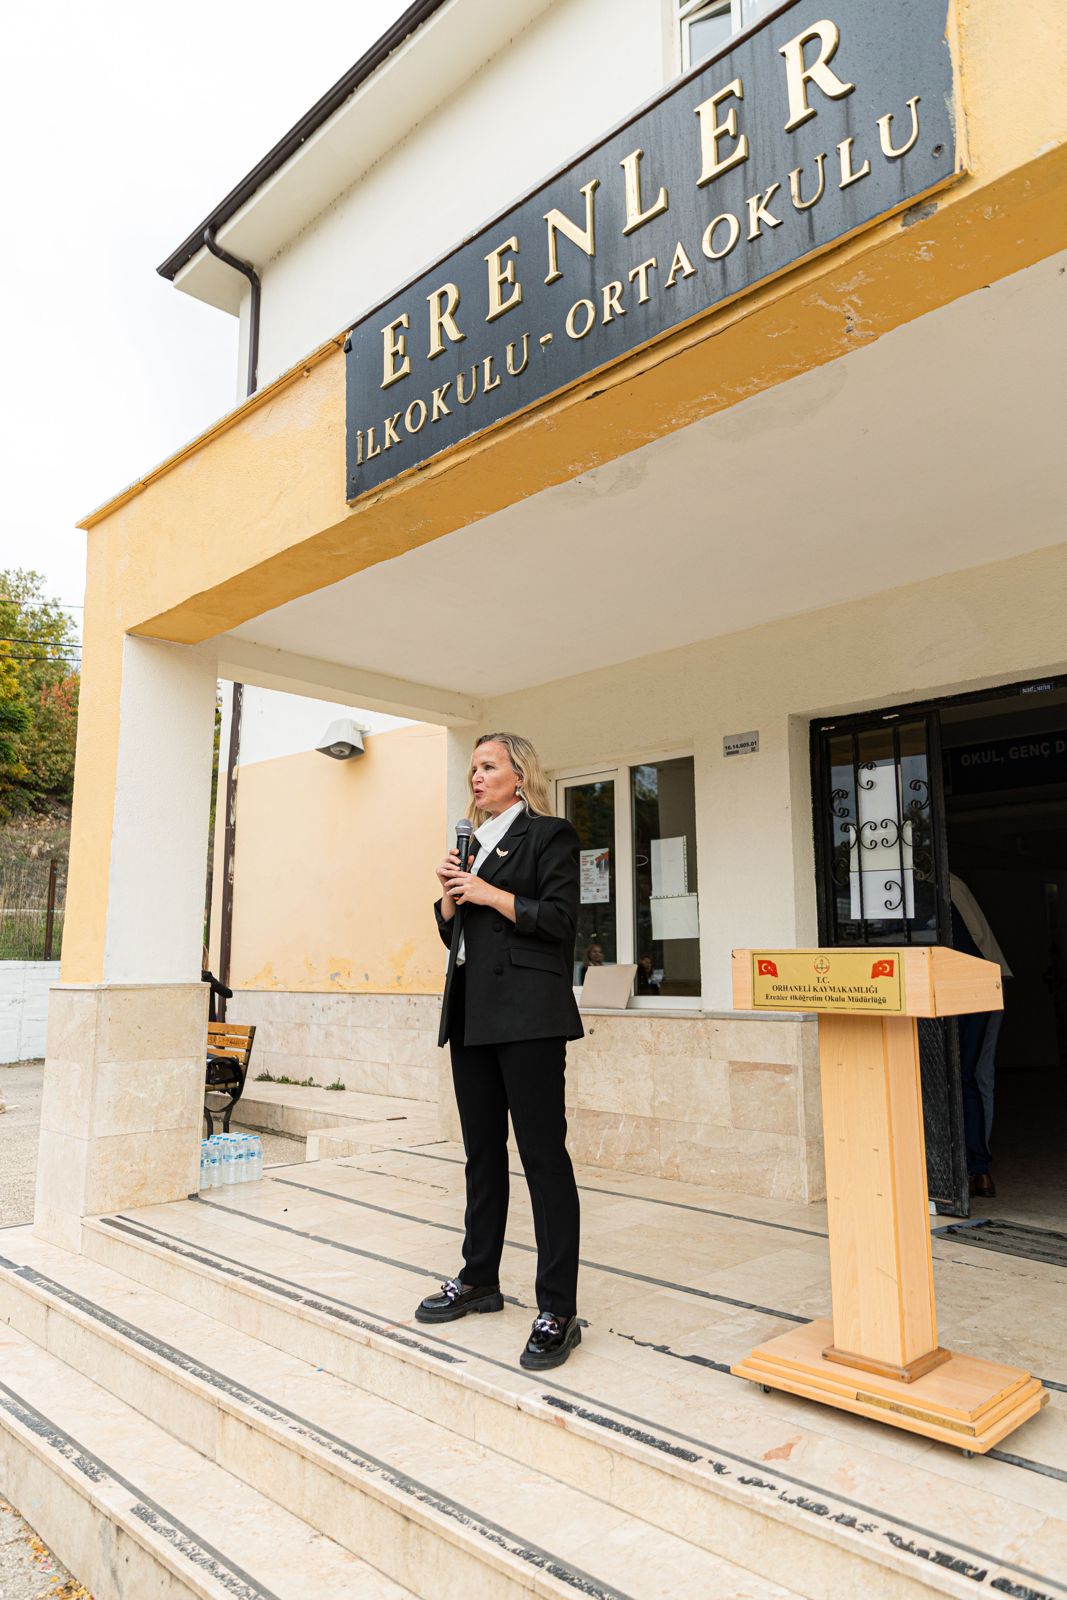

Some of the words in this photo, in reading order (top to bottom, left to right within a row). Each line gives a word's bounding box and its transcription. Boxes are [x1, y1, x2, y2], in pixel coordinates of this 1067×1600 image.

[379, 18, 857, 390] ERENLER
[960, 749, 1005, 766] OKUL,
[1008, 742, 1050, 758] GENÇ
[772, 984, 811, 992] ORHANELİ
[812, 985, 878, 994] KAYMAKAMLIĞI
[847, 995, 887, 1004] Müdürlüğü
